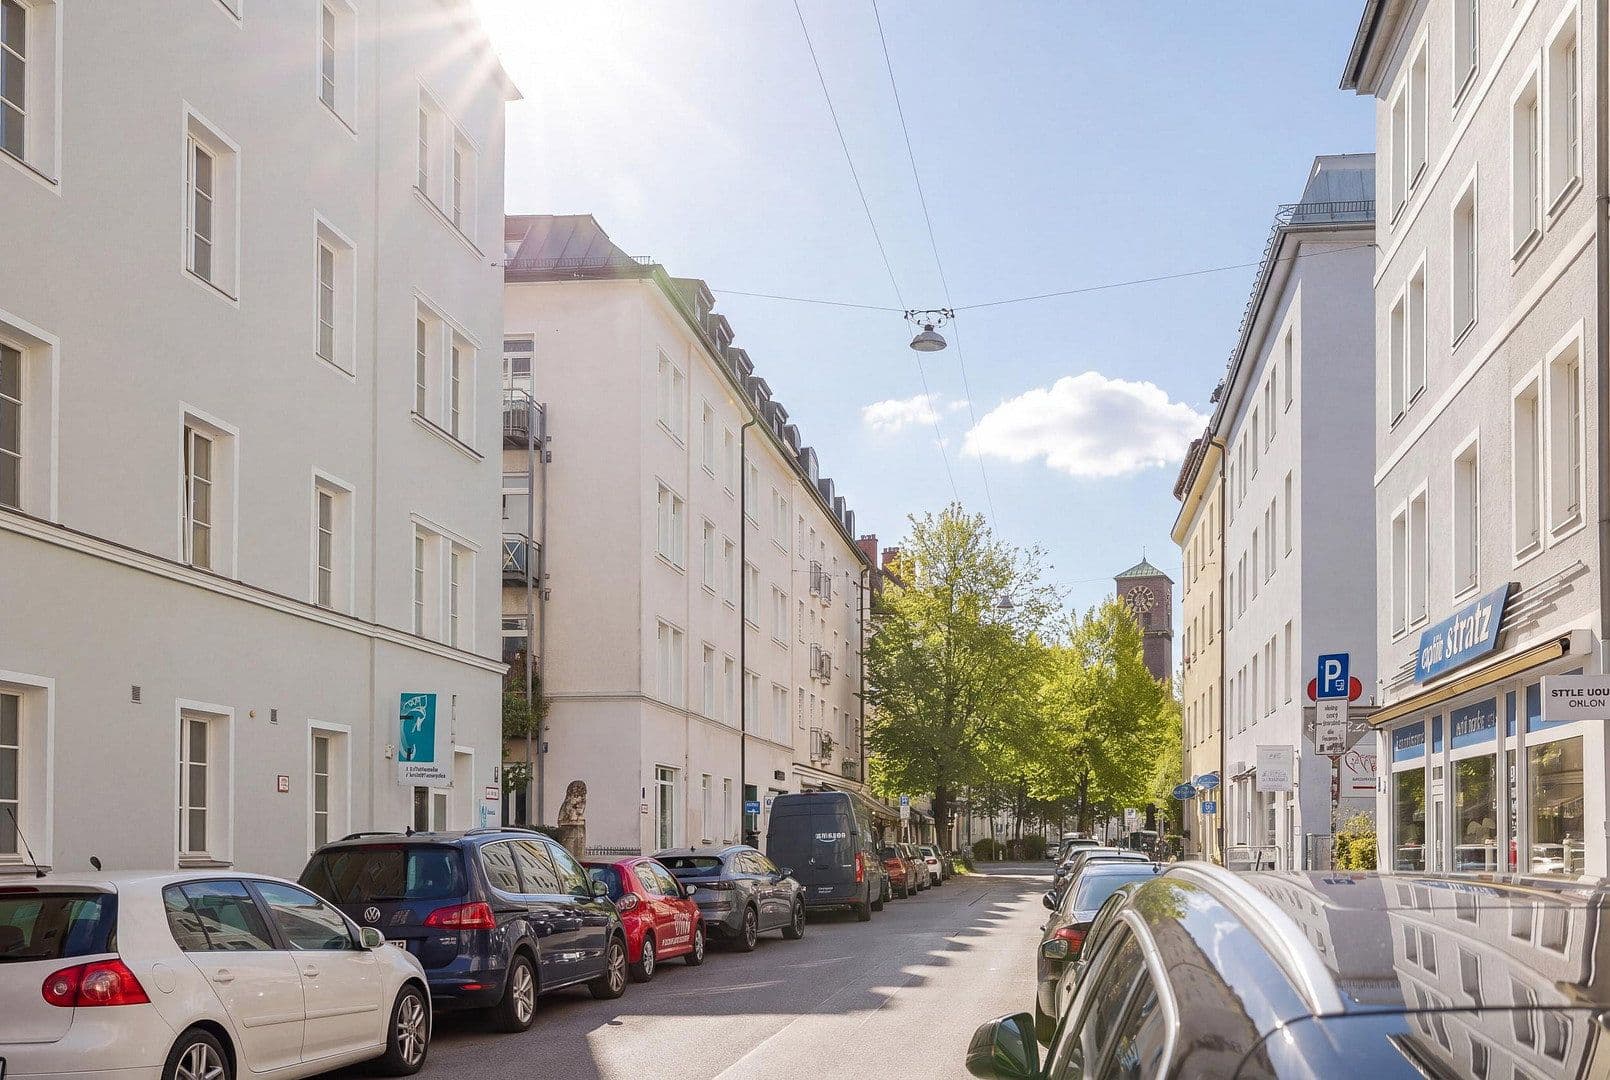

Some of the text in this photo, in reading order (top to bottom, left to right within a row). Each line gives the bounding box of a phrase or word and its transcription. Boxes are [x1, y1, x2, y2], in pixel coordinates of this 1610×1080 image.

[1445, 602, 1492, 660] stratz
[1324, 659, 1342, 693] P
[1551, 688, 1584, 698] STYLE
